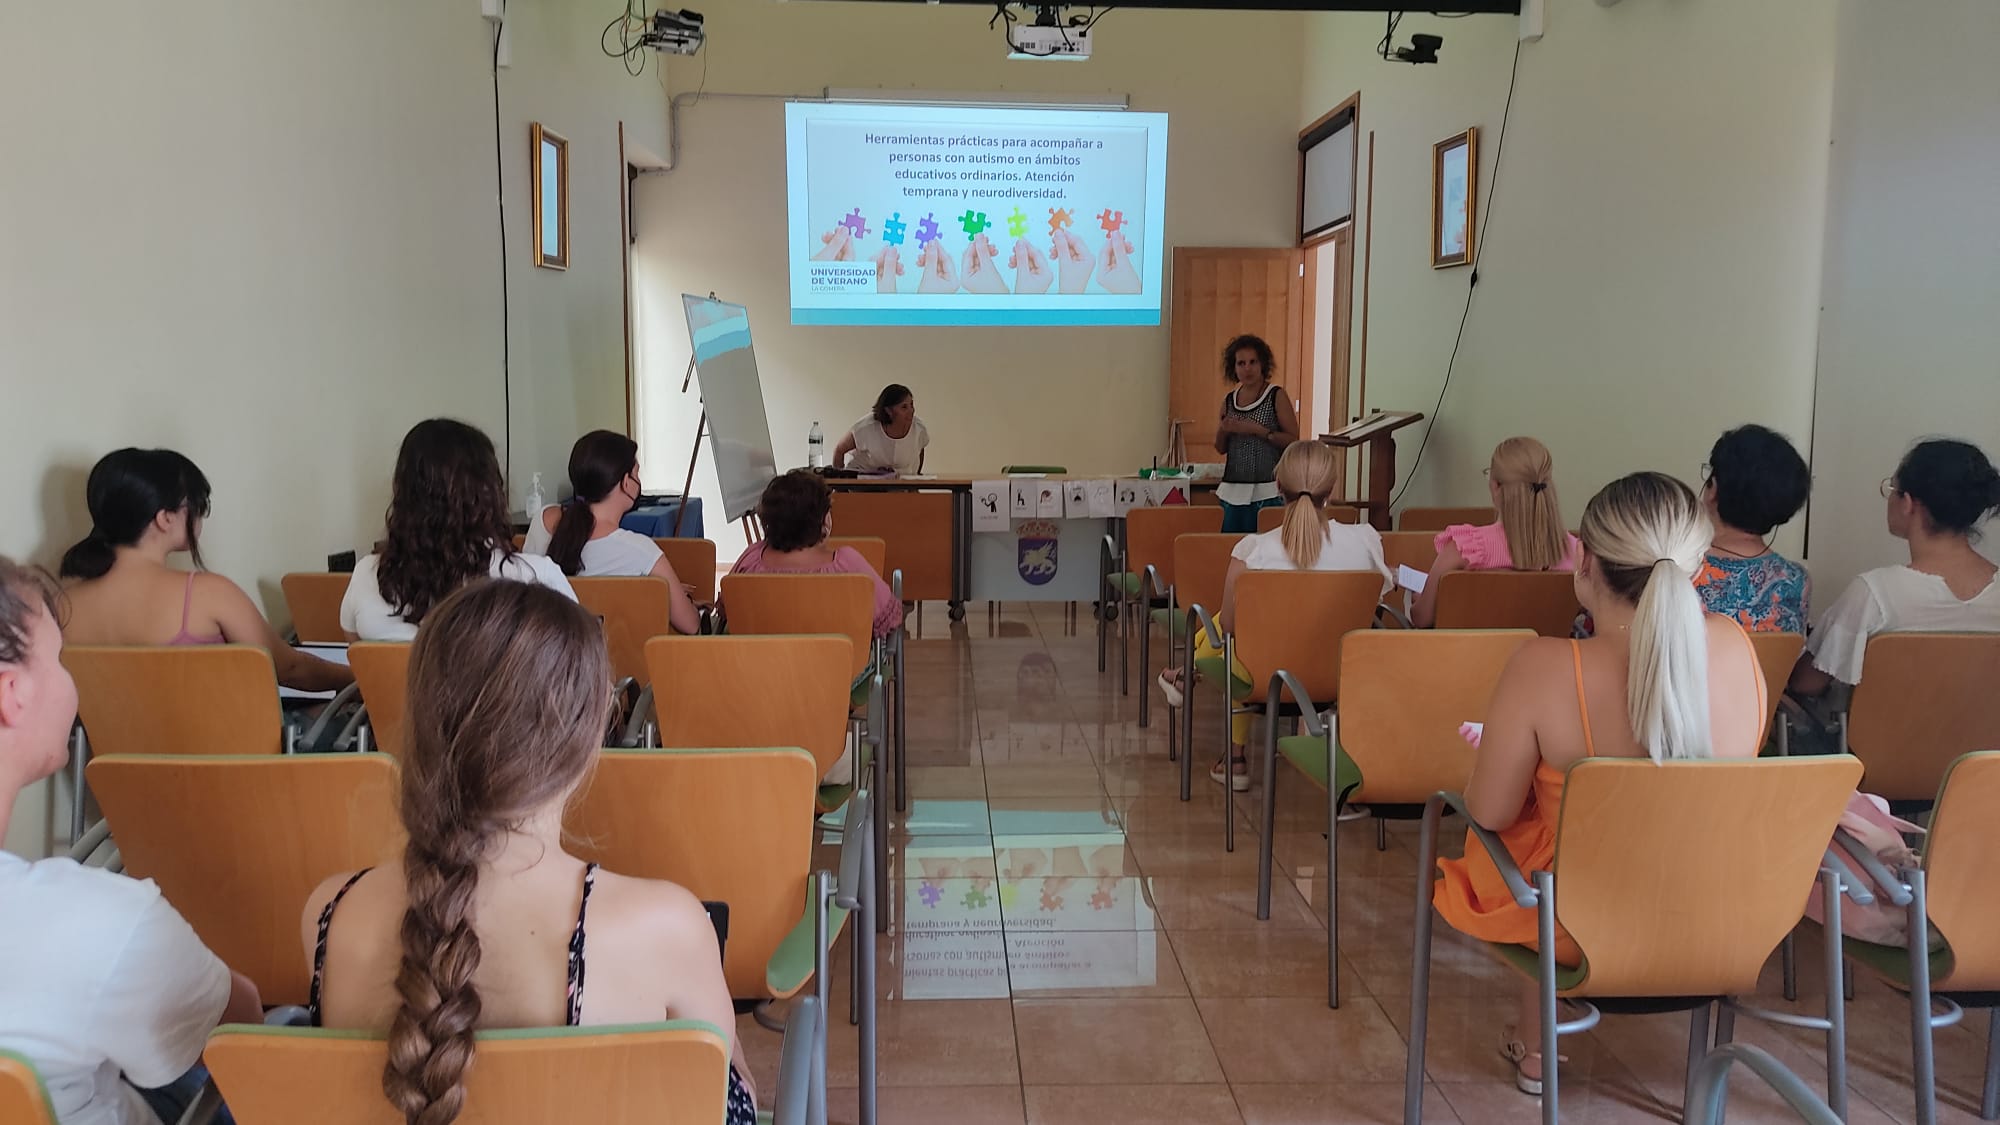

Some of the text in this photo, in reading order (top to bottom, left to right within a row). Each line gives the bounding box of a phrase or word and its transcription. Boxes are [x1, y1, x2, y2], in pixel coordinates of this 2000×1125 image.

[865, 133, 1103, 150] Herramientas prácticas para acompañar a
[889, 153, 1081, 166] personas con autismo en ámbitos
[895, 168, 1075, 183] educativos ordinarios. Atención
[903, 186, 1067, 199] temprana y neurodiversidad.
[810, 268, 876, 276] UNIVERSIDAD
[811, 277, 868, 285] DE VERANO
